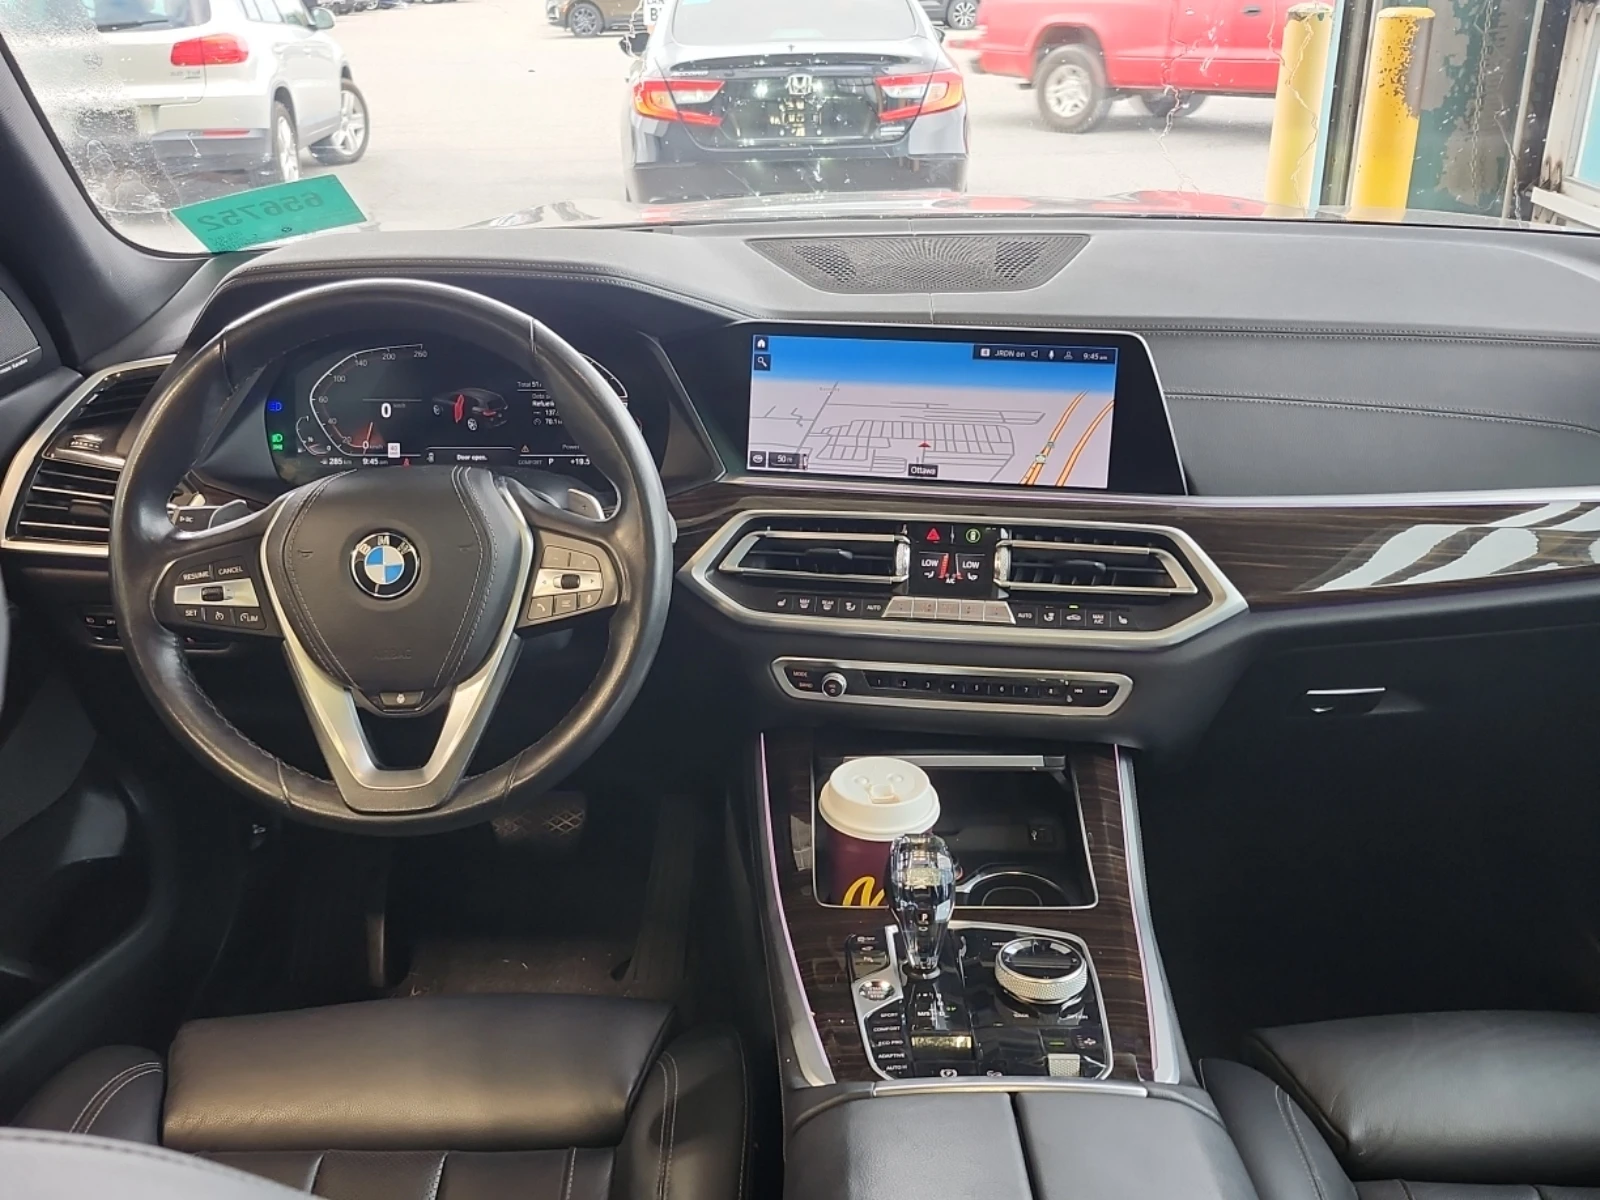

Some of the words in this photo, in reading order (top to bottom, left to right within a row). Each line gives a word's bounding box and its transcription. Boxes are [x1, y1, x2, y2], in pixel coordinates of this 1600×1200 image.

[414, 350, 427, 358] 260
[1083, 352, 1099, 360] 9:45
[381, 402, 391, 418] 0
[777, 455, 787, 463] 50
[910, 467, 936, 475] Ottawa
[358, 535, 409, 556] BMW
[921, 559, 939, 567] LOW
[962, 561, 980, 569] LOW
[218, 565, 243, 576] CANCEL
[182, 571, 210, 581] RESUME
[185, 609, 197, 617] SET
[922, 913, 928, 922] P
